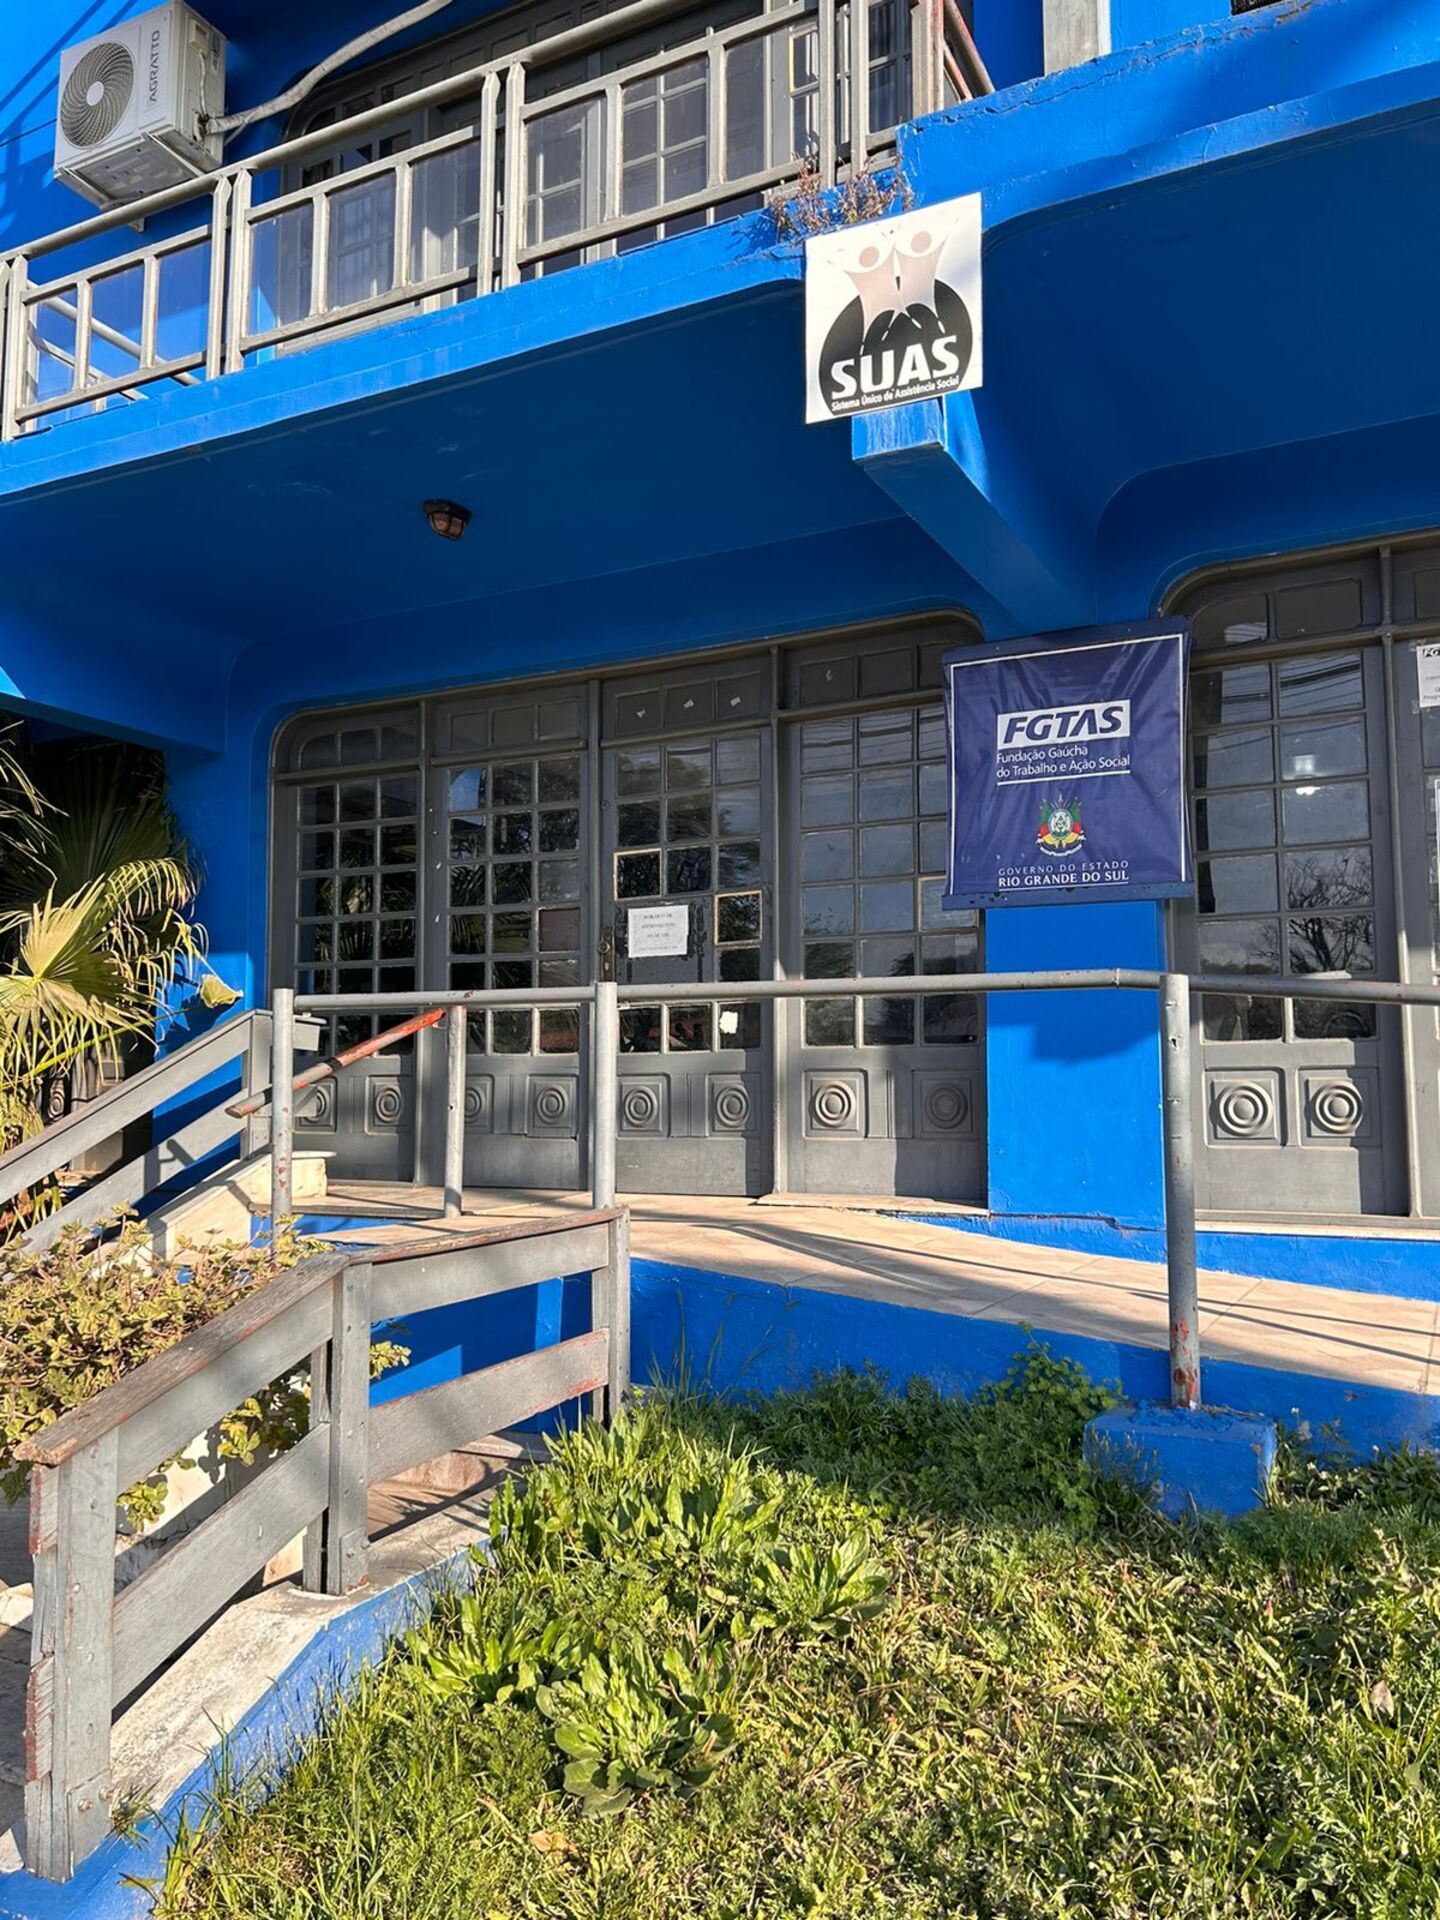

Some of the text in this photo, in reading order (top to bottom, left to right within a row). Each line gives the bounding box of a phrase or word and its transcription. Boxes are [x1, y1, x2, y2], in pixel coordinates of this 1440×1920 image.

[149, 30, 161, 102] AGRATTO
[831, 335, 960, 399] SUAS
[831, 375, 960, 411] Sistema Único de Assistência Social
[1003, 706, 1124, 744] FGTAS
[997, 745, 1088, 764] Fundação Gaúcha
[997, 754, 1130, 778] do Trabalho e Ação Social
[998, 860, 1129, 876] GOVERNO DO ESTADO
[998, 870, 1130, 887] RIO GRANDE DO SUL
